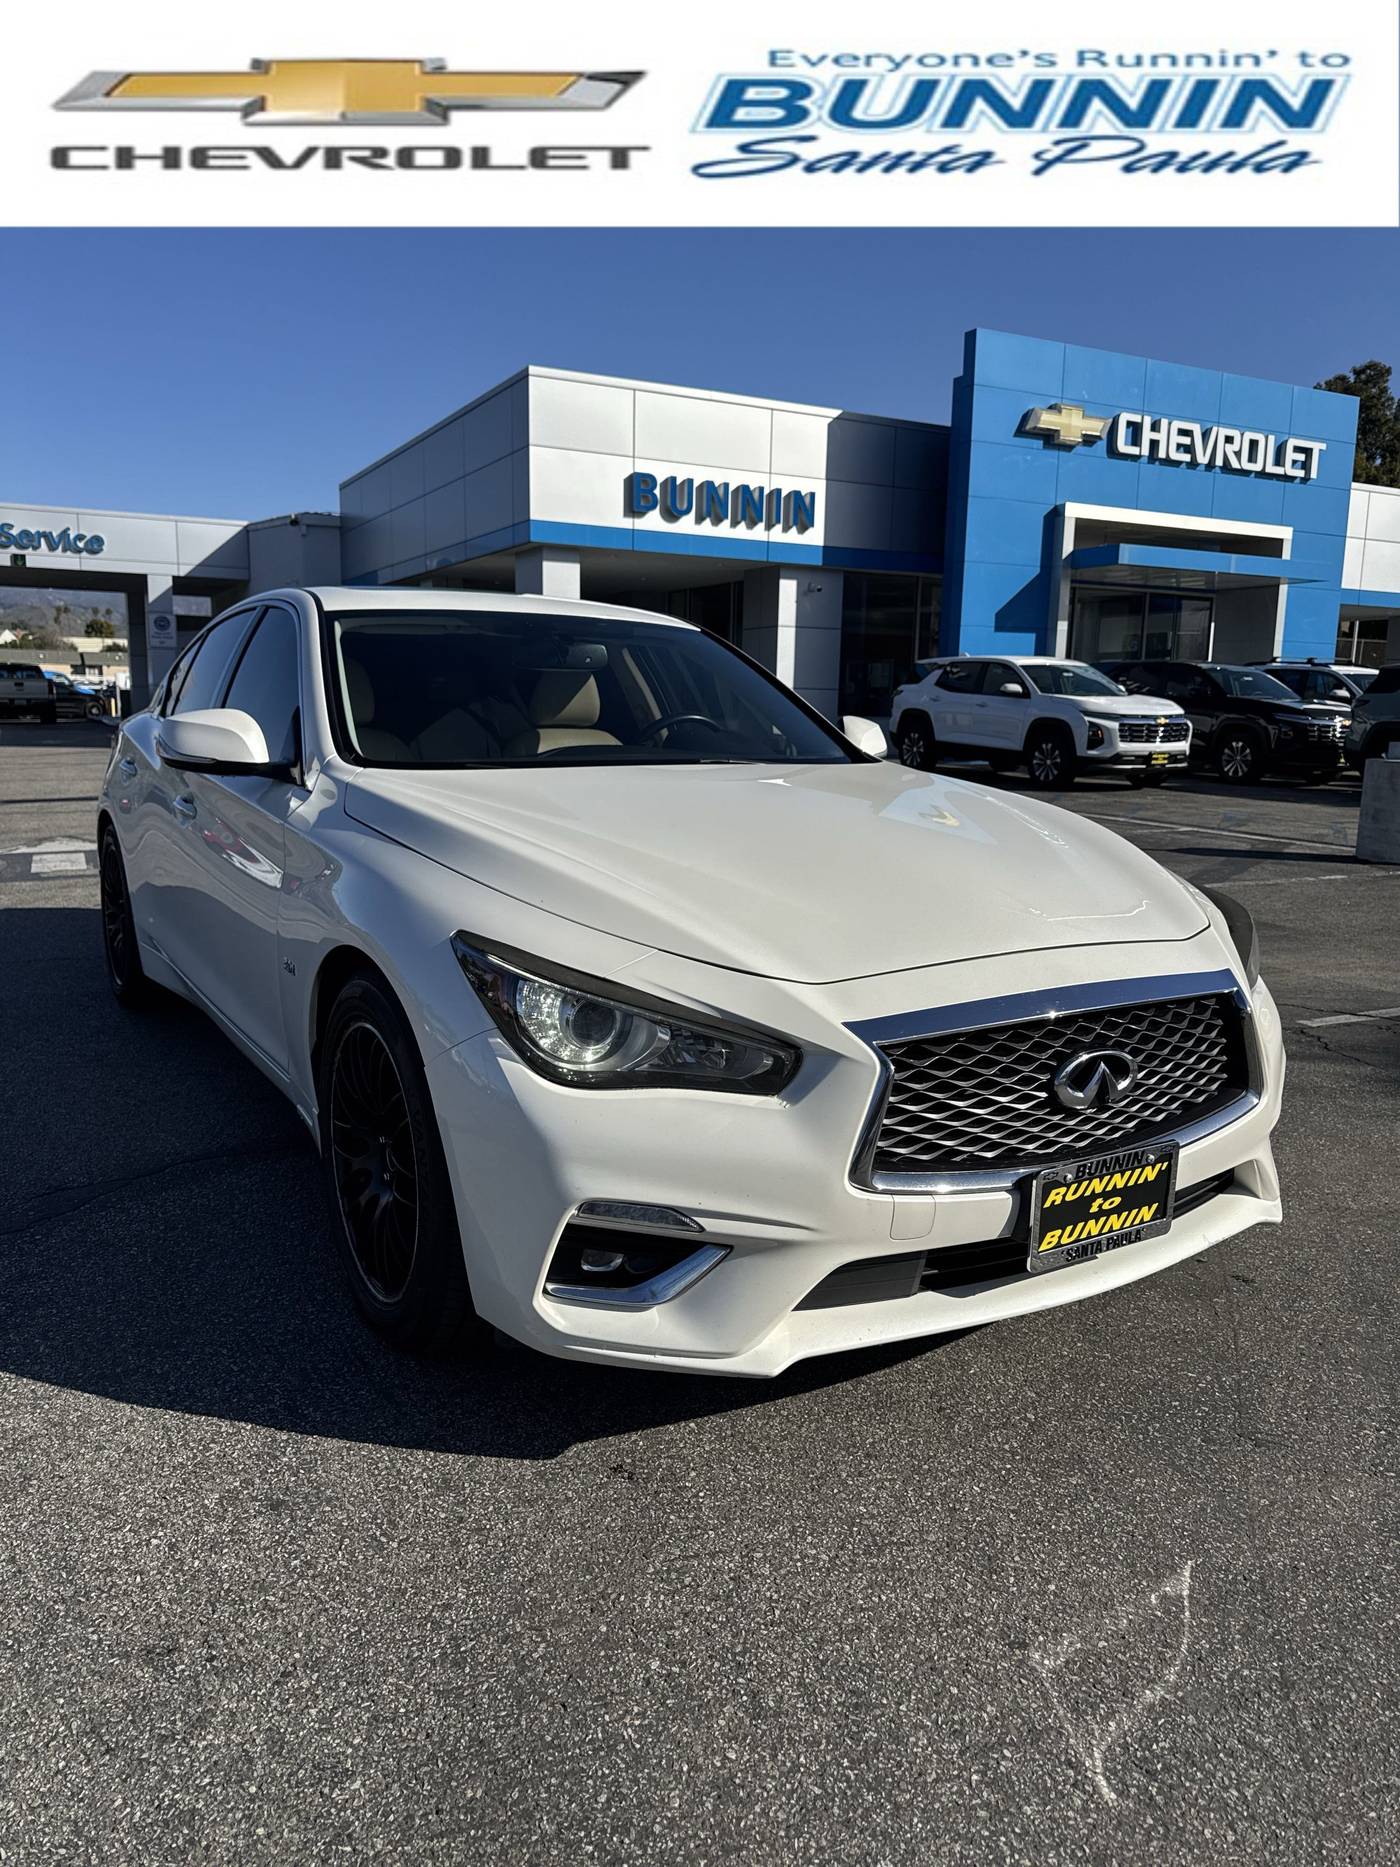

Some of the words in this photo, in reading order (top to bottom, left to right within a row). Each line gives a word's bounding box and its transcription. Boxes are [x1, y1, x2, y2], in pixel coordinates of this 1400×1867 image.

[1112, 411, 1327, 481] CHEVROLET
[623, 471, 816, 535] BUNNIN
[0, 522, 105, 555] Service
[1043, 1161, 1169, 1208] RUNNIN'
[1075, 1150, 1146, 1180] BUNNIN
[1089, 1196, 1122, 1213] to
[1038, 1202, 1159, 1252] BUNNIN
[1065, 1240, 1102, 1262] SANTA
[1105, 1229, 1142, 1251] PAULA
